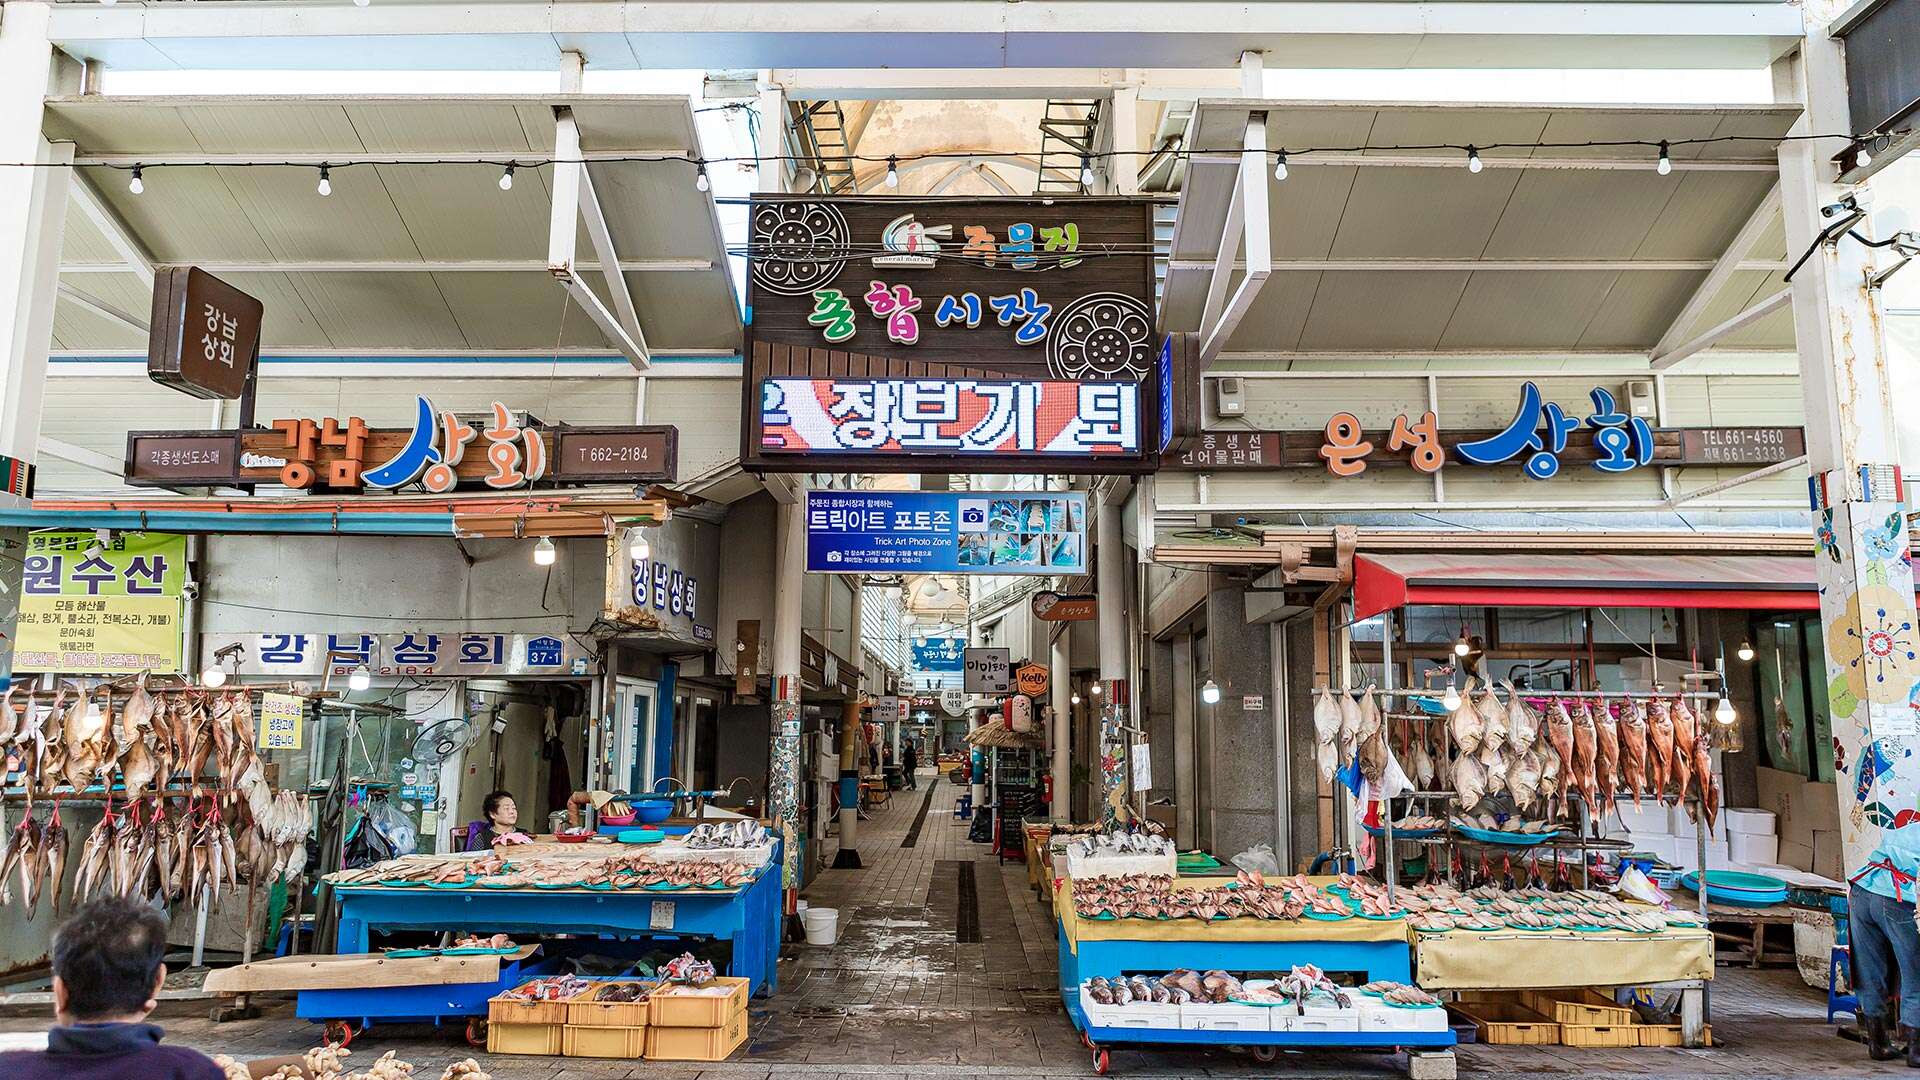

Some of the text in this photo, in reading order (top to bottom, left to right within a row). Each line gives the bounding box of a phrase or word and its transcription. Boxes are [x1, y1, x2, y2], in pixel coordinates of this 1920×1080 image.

[963, 222, 1083, 268] 주문진
[807, 279, 1053, 345] 종합시장
[204, 303, 238, 341] 강남
[202, 333, 235, 369] 상회
[829, 379, 1037, 449] 장보기
[1320, 380, 1655, 480] 은성 상회
[272, 393, 545, 493] 강남 상회
[151, 450, 221, 467] 각종생선도소매
[579, 446, 648, 463] T 662-2184
[1723, 446, 1786, 461] 661-3338
[809, 499, 894, 508] 주문진 종합시장과 함께하는
[809, 510, 952, 532] 트릭아트 포토존
[874, 537, 952, 546] Trick Art Photo Zone
[633, 560, 697, 620] 강남상회
[77, 601, 106, 611] 해산물
[42, 613, 64, 625] 멍게,
[67, 613, 99, 625] 뿔소라,
[102, 614, 144, 626] 전복소라,
[59, 627, 95, 638] 문어숙회
[59, 641, 95, 652] 해물라면
[531, 651, 559, 664] 37-1
[1021, 672, 1048, 685] Kelly
[947, 700, 962, 708] 식당
[269, 718, 294, 731] 냉장고에
